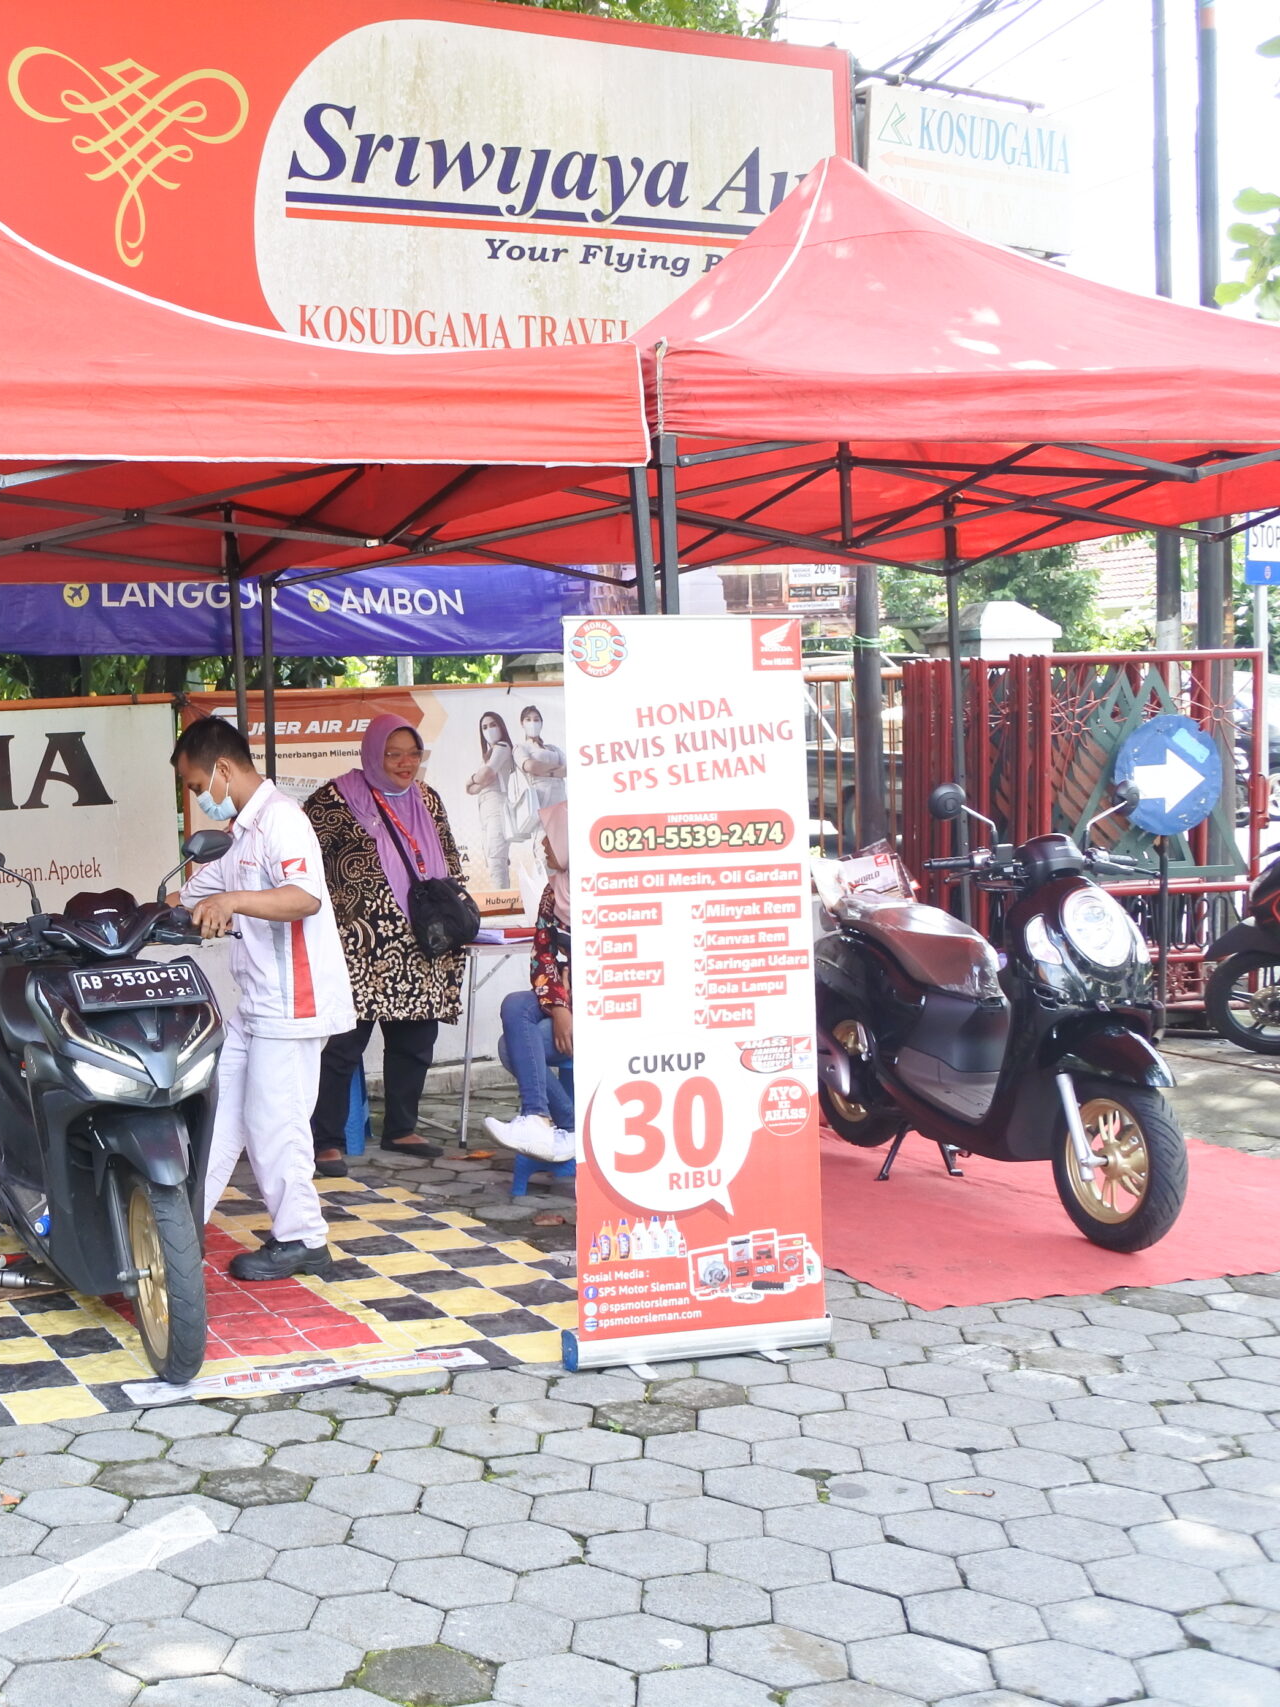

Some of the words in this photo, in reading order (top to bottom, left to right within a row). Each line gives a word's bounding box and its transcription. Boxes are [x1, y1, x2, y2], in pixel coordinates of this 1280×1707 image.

[919, 105, 1070, 175] KOSUDGAMA
[287, 102, 691, 223] Sriwijaya
[484, 237, 569, 263] Your
[579, 243, 691, 278] Flying
[298, 304, 513, 349] KOSUDGAMA
[339, 586, 466, 616] AMBON
[567, 634, 629, 663] SPS
[636, 697, 734, 728] HONDA
[304, 719, 342, 735] AIR
[578, 735, 665, 767] SERVIS
[675, 719, 794, 755] KUNJUNG
[613, 766, 659, 793] SPS
[668, 753, 767, 786] SLEMAN
[667, 813, 718, 823] INFORMASI
[599, 821, 785, 853] 0821-5539-2474
[597, 875, 639, 891] Ganti
[642, 874, 664, 888] Oli
[668, 871, 716, 887] Mesin,
[719, 870, 742, 884] Oli
[744, 868, 799, 883] Gardan
[597, 907, 658, 923] Coolant
[706, 902, 760, 920] Minyak
[763, 900, 797, 914] Rem
[602, 939, 634, 954] Ban
[706, 933, 756, 946] Kanvas
[758, 930, 787, 944] Rem
[706, 958, 765, 971] Saringan
[768, 954, 809, 967] Udara
[79, 972, 103, 991] AB
[169, 966, 190, 983] EV
[603, 966, 663, 984] Battery
[707, 982, 739, 995] Bola
[741, 978, 785, 994] Lampu
[604, 998, 638, 1013] Busi
[708, 1007, 754, 1022] Vbelt
[627, 1051, 707, 1075] CUKUP
[613, 1075, 725, 1174] 30
[667, 1168, 722, 1191] RIBU
[582, 1270, 613, 1284] Sosial
[614, 1268, 645, 1281] Media
[598, 1286, 617, 1298] SPS
[618, 1284, 649, 1296] Motor
[650, 1281, 687, 1293] Sleman
[599, 1296, 690, 1315] @spsmotorsleman
[598, 1309, 703, 1329] spsmotorsleman.com
